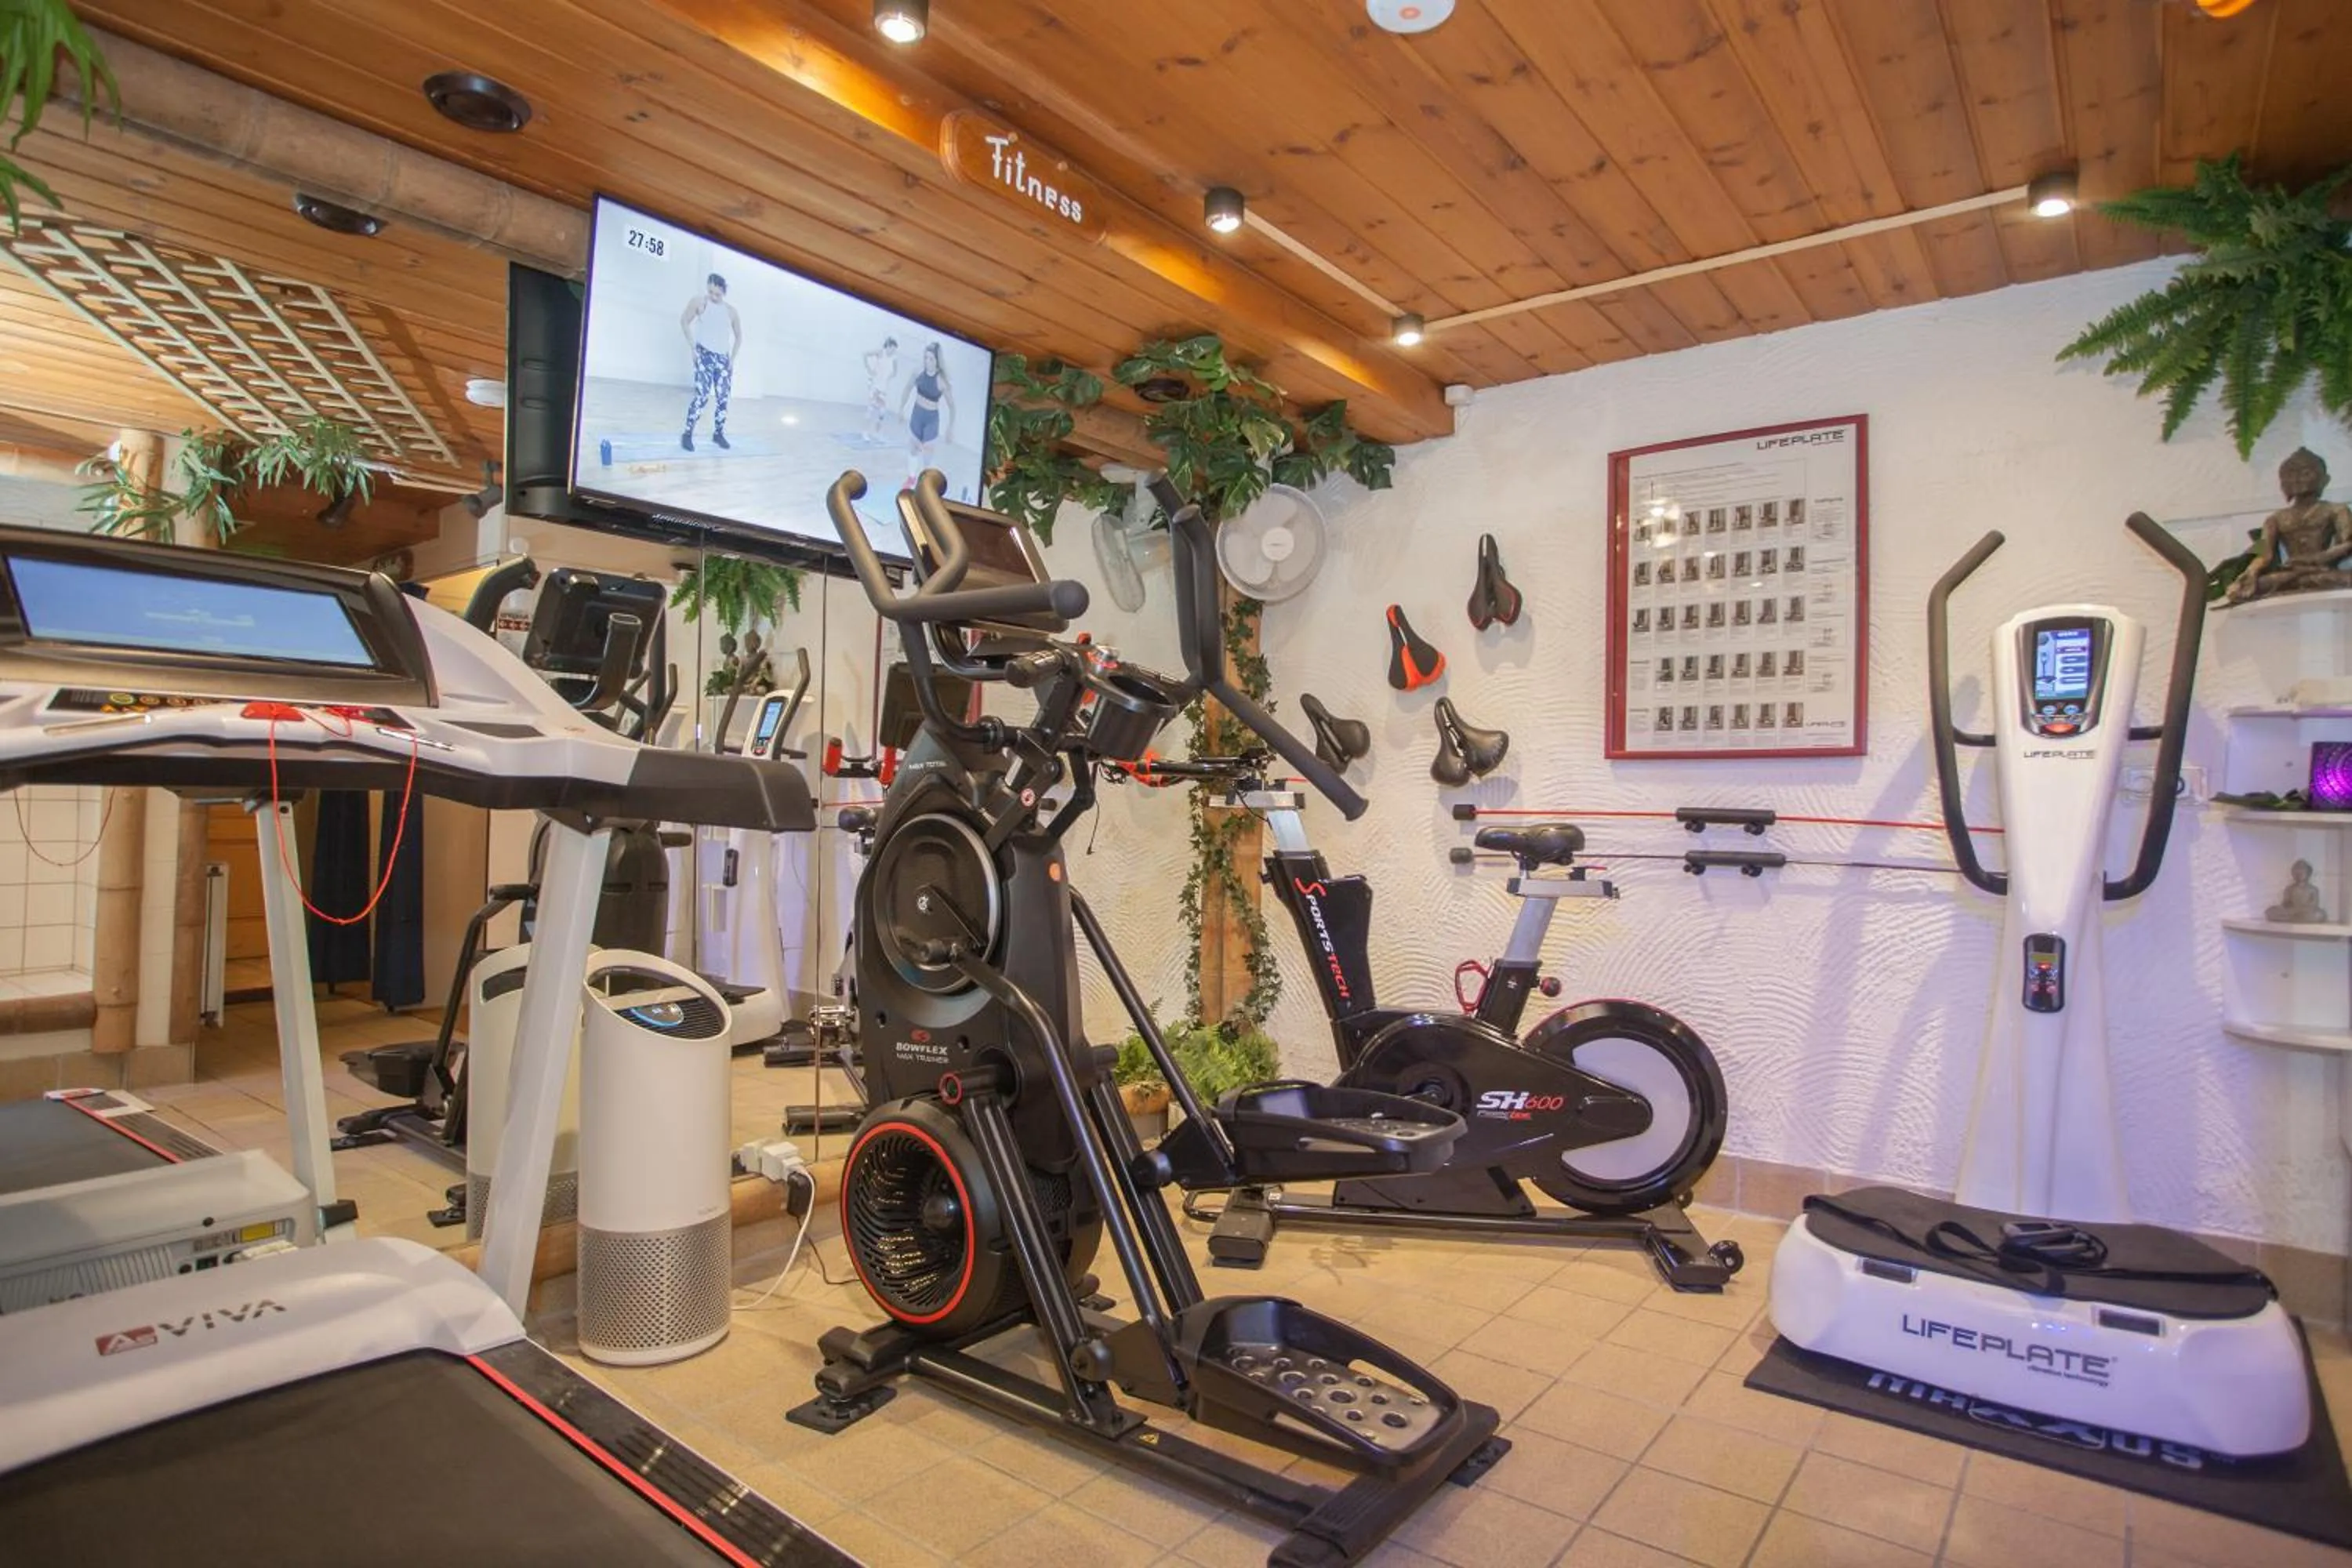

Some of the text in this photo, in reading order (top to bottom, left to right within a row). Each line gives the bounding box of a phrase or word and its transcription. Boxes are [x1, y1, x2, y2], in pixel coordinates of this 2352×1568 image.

[628, 230, 664, 256] 27:58
[1756, 429, 1845, 450] LIFEPLATE
[895, 1041, 948, 1056] BOWFLEX
[1902, 1314, 2111, 1378] LIFEPLATE
